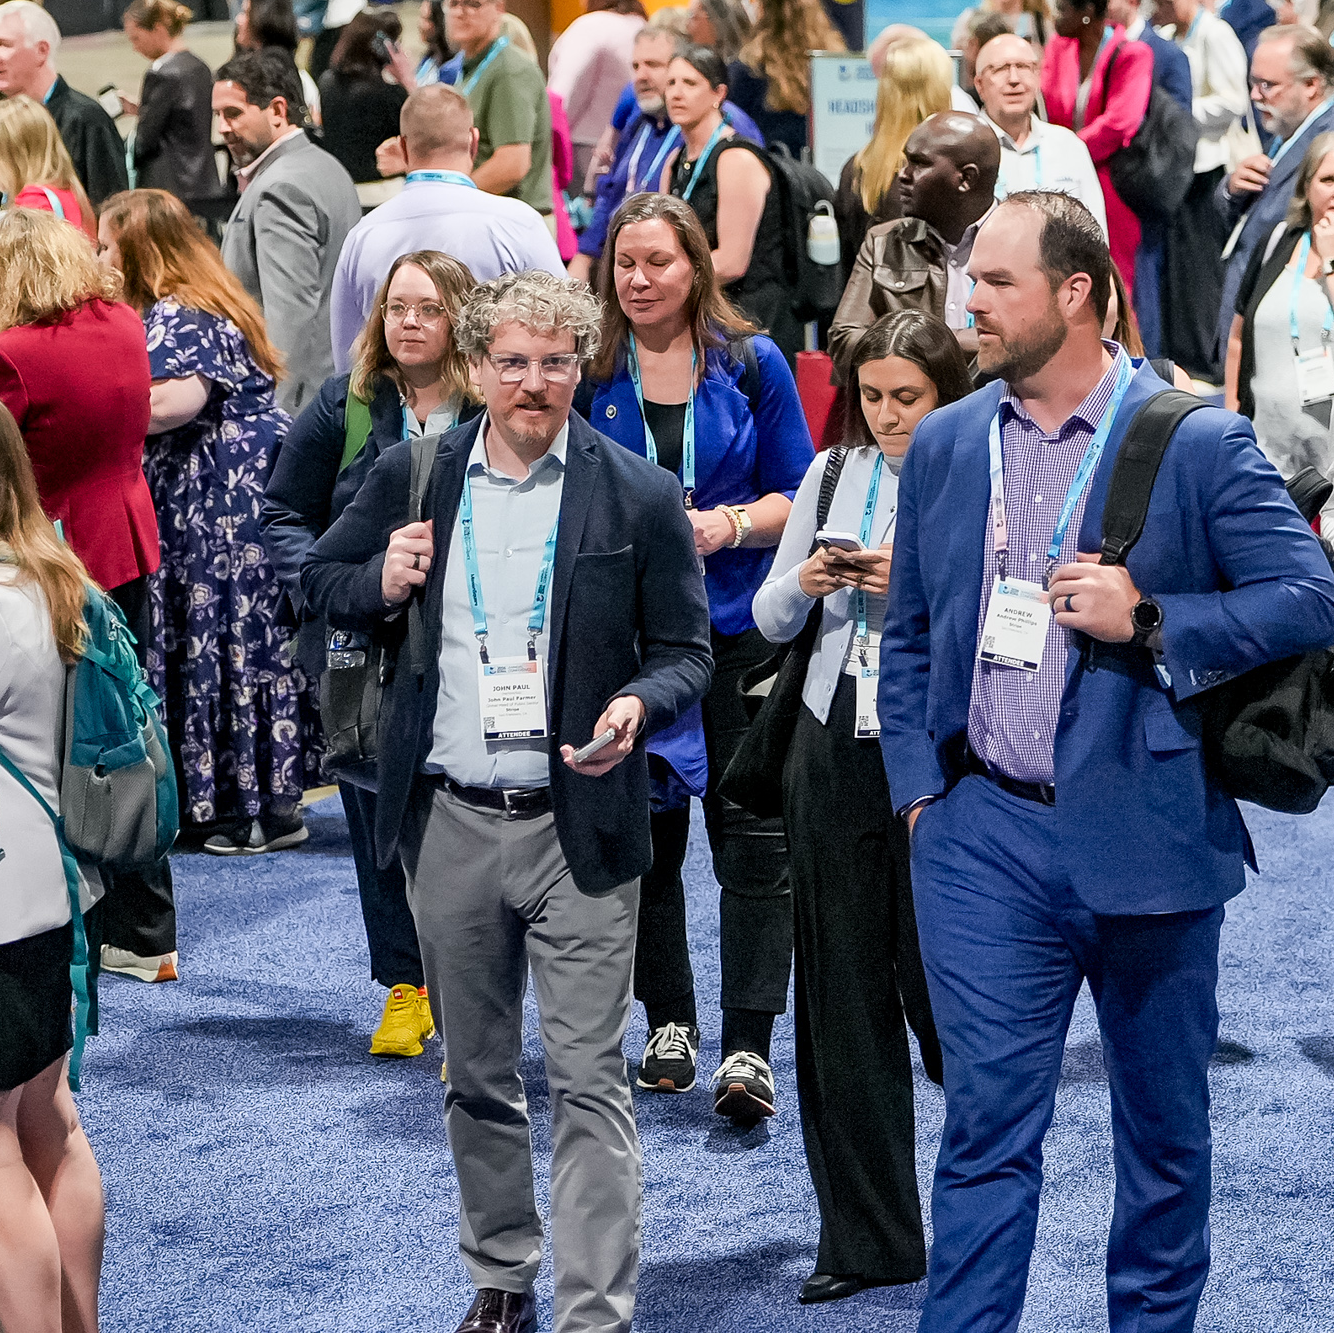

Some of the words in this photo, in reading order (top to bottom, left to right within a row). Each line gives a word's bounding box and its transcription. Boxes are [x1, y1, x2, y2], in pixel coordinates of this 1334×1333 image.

[1004, 608, 1033, 618] ANDREW
[992, 654, 1025, 667] ATTENDEE
[497, 730, 531, 739] ATTENDEE
